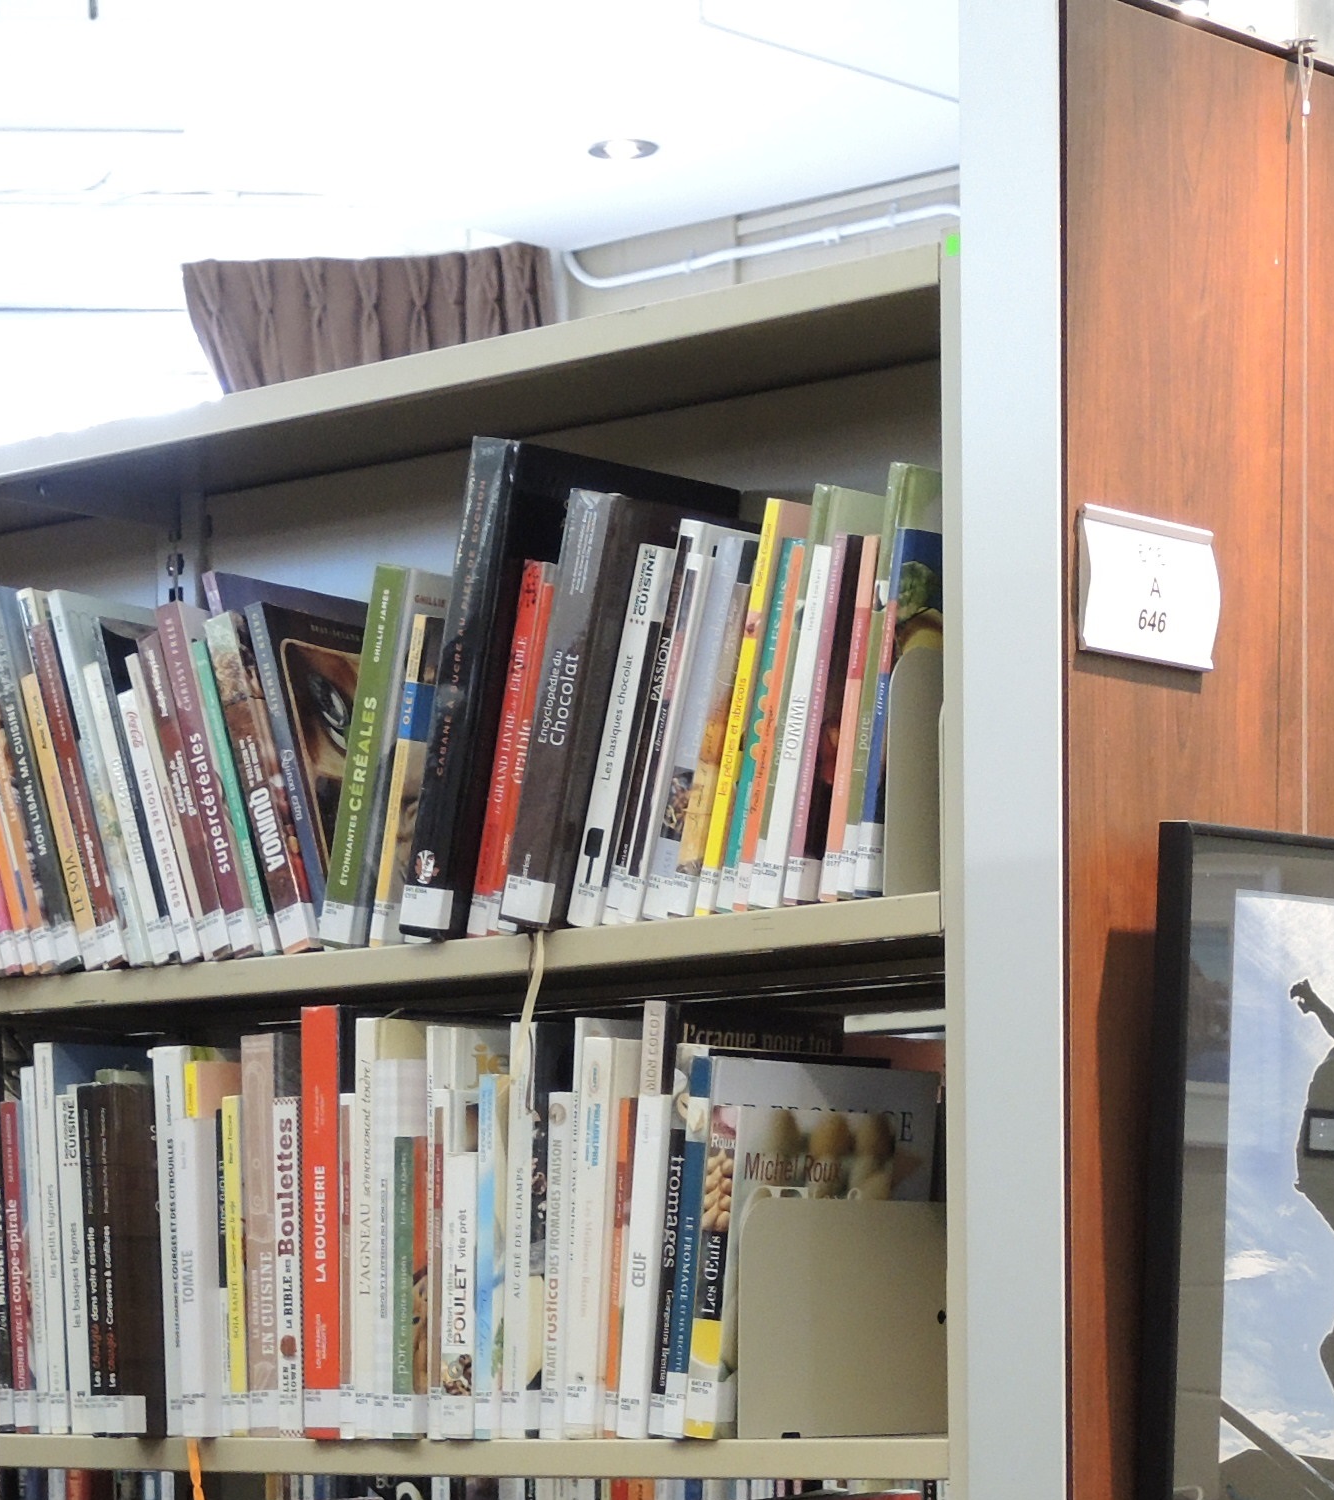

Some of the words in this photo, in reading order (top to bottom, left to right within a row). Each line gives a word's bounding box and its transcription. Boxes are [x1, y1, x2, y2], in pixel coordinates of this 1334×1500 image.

[378, 588, 391, 622] JAMES
[1138, 608, 1168, 634] 646
[372, 624, 386, 663] GHILLIE
[649, 636, 672, 702] PASSION
[536, 668, 563, 744] Encyclopédie
[551, 649, 564, 666] du
[548, 653, 581, 746] Chocolat
[729, 677, 748, 722] abricots
[6, 703, 26, 755] CUISINE
[725, 723, 738, 735] et
[782, 693, 806, 763] POMME
[19, 757, 31, 779] MA
[348, 696, 378, 812] CÉRÉALES
[719, 737, 740, 777] pêches
[28, 781, 42, 822] LIBAN,
[140, 768, 162, 826] HISTOIRE
[187, 732, 232, 874] supercéréales
[716, 779, 731, 797] les
[36, 826, 48, 856] MON
[155, 829, 168, 842] ET
[249, 786, 286, 872] QUINOA
[338, 814, 359, 886] ÉTONNANTES
[161, 847, 181, 908] RECETTES
[276, 1117, 296, 1257] Boulettes
[744, 1152, 795, 1181] Michel
[803, 1153, 842, 1183] Roux
[313, 1165, 327, 1260] BOUCHERIE
[456, 1208, 470, 1234] prêt
[5, 1199, 23, 1303] coupe-spirale
[358, 1202, 373, 1296] L'AGNEAU
[457, 1237, 468, 1259] vite
[631, 1251, 646, 1288] ŒUF
[704, 1235, 722, 1281] Œufs
[181, 1249, 196, 1304] TOMATE
[260, 1250, 274, 1326] CUISINE
[313, 1264, 327, 1283] LA
[13, 1304, 22, 1315] LE
[251, 1268, 261, 1327] CHAMPIGNON
[282, 1275, 294, 1316] BIBLE
[453, 1265, 468, 1345] POULET
[702, 1285, 718, 1315] Les
[14, 1317, 24, 1343] AVEC
[261, 1331, 275, 1355] EN
[284, 1319, 292, 1329] LA
